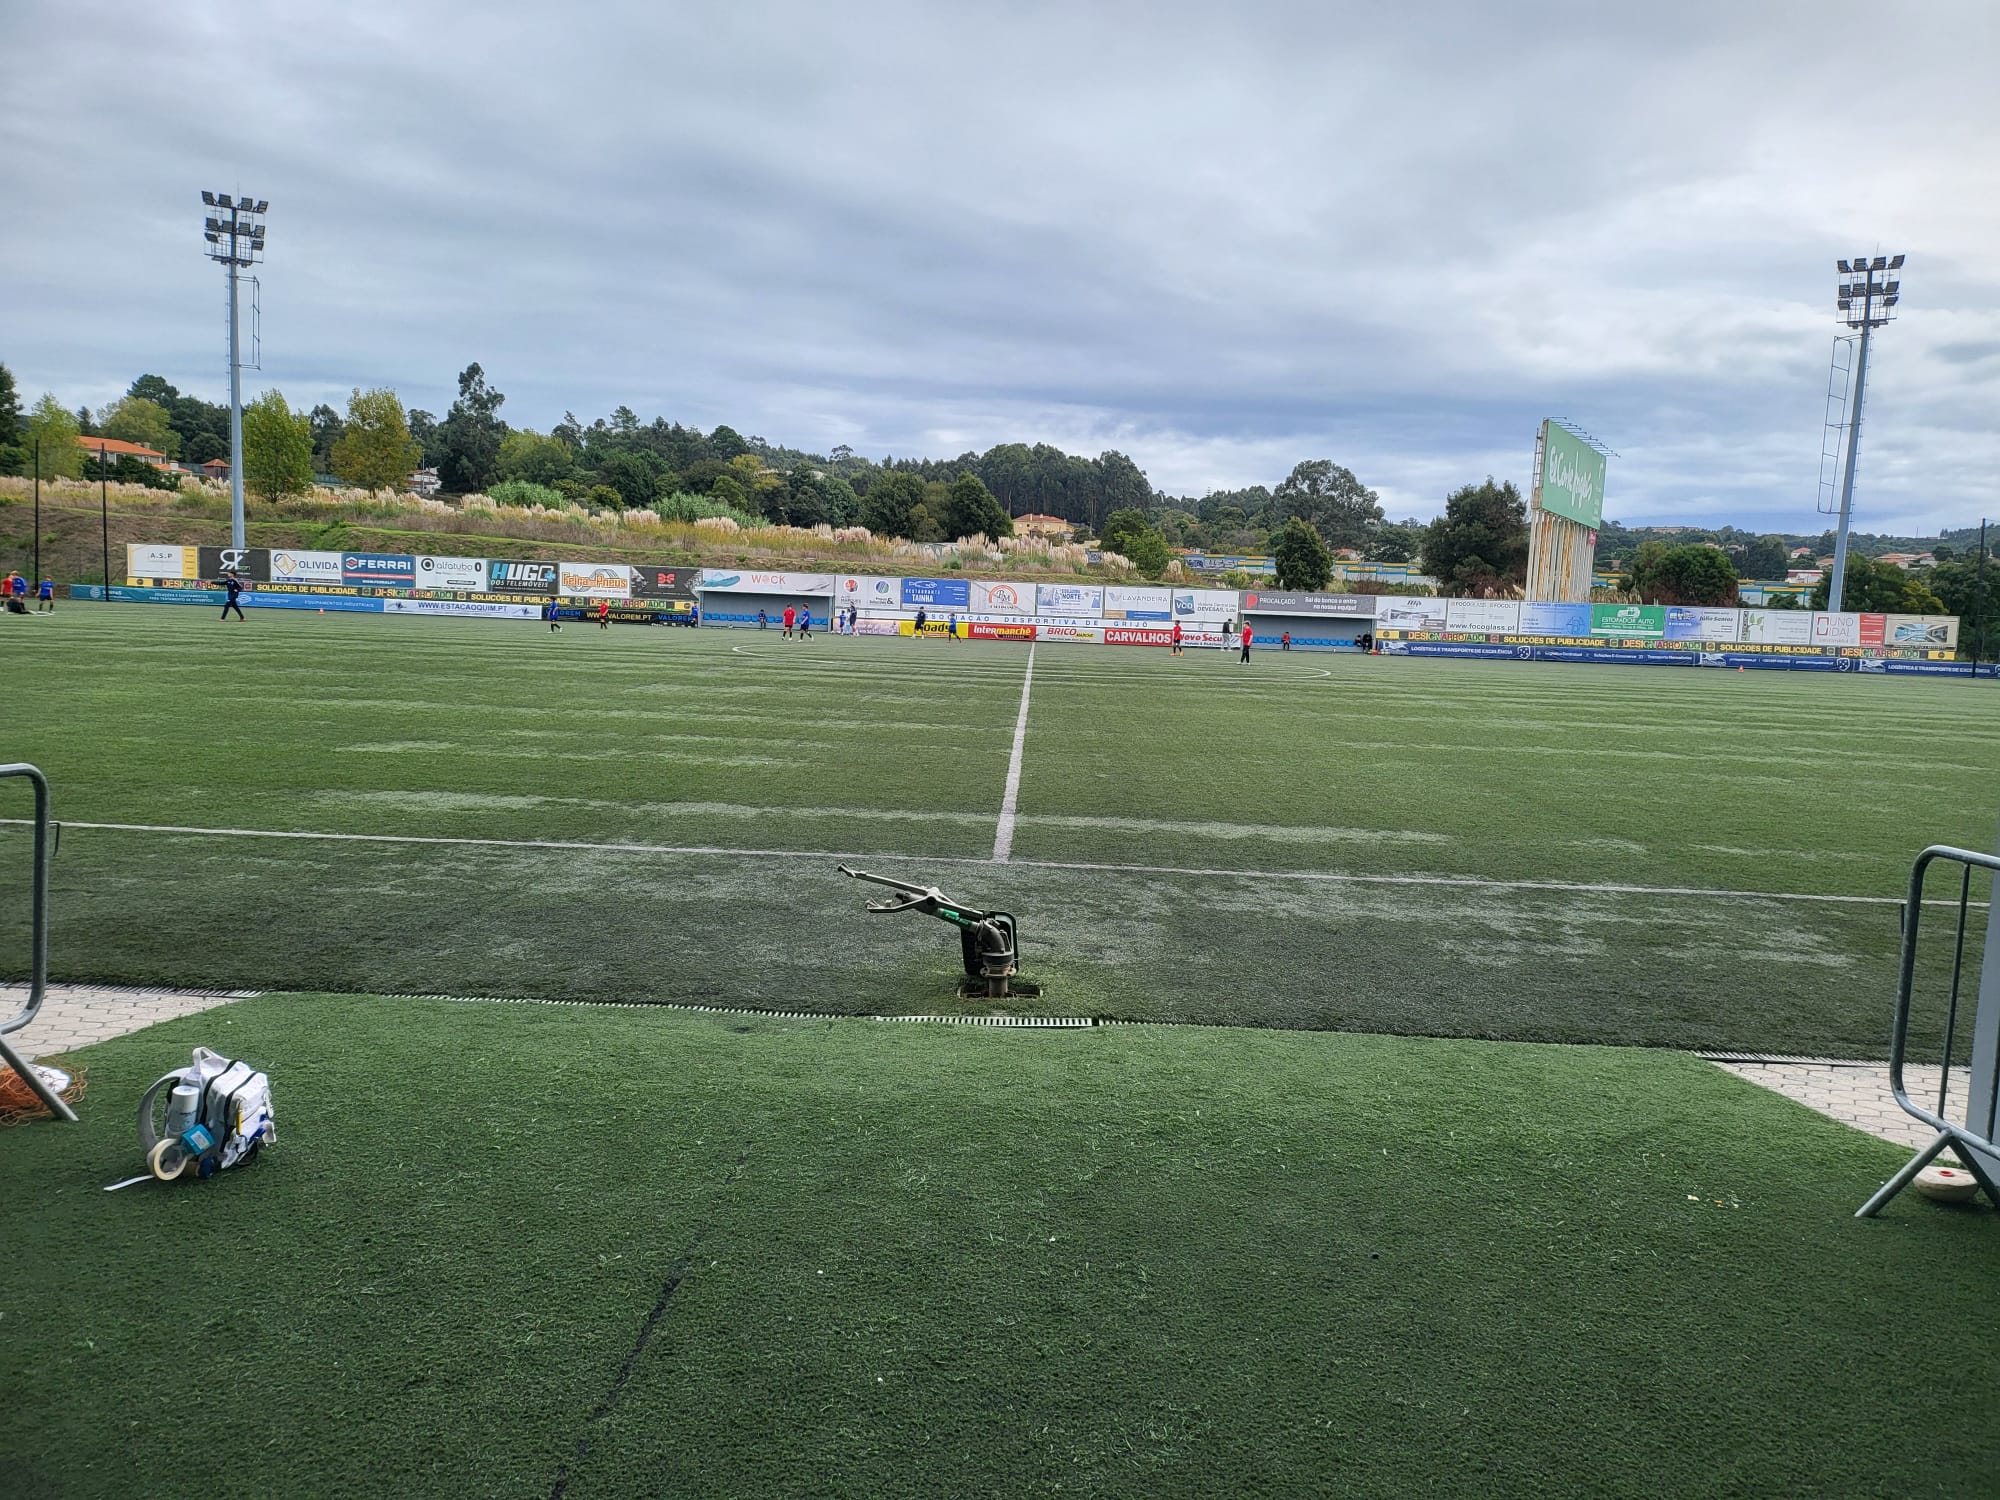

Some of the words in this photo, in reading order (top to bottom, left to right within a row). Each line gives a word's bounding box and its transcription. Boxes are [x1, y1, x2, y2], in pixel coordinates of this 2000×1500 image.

[298, 560, 339, 570] OLIVIDA
[358, 559, 411, 570] FERRAI
[595, 574, 628, 589] Pneus
[299, 585, 309, 593] DE
[310, 586, 358, 595] PUBLICIDADE
[512, 595, 522, 603] DE
[524, 596, 571, 605] PUBLICADE
[911, 594, 934, 603] TAINHA
[1259, 597, 1296, 605] PROCALÇADO
[546, 608, 581, 617] VOREM
[586, 611, 652, 620] WWVALOREM.PT
[1004, 617, 1077, 625] DESPORTIVA
[924, 622, 950, 633] oads
[1047, 627, 1077, 636] BRICO
[1449, 623, 1515, 631] www.focoglass.pt
[1106, 631, 1171, 643] CARVALHOS
[1202, 633, 1223, 642] Secu
[1546, 637, 1556, 645] DE
[1557, 638, 1605, 646] PUBLICIDADE
[1763, 645, 1773, 653] DE
[1774, 645, 1822, 654] PUBLICIDADE
